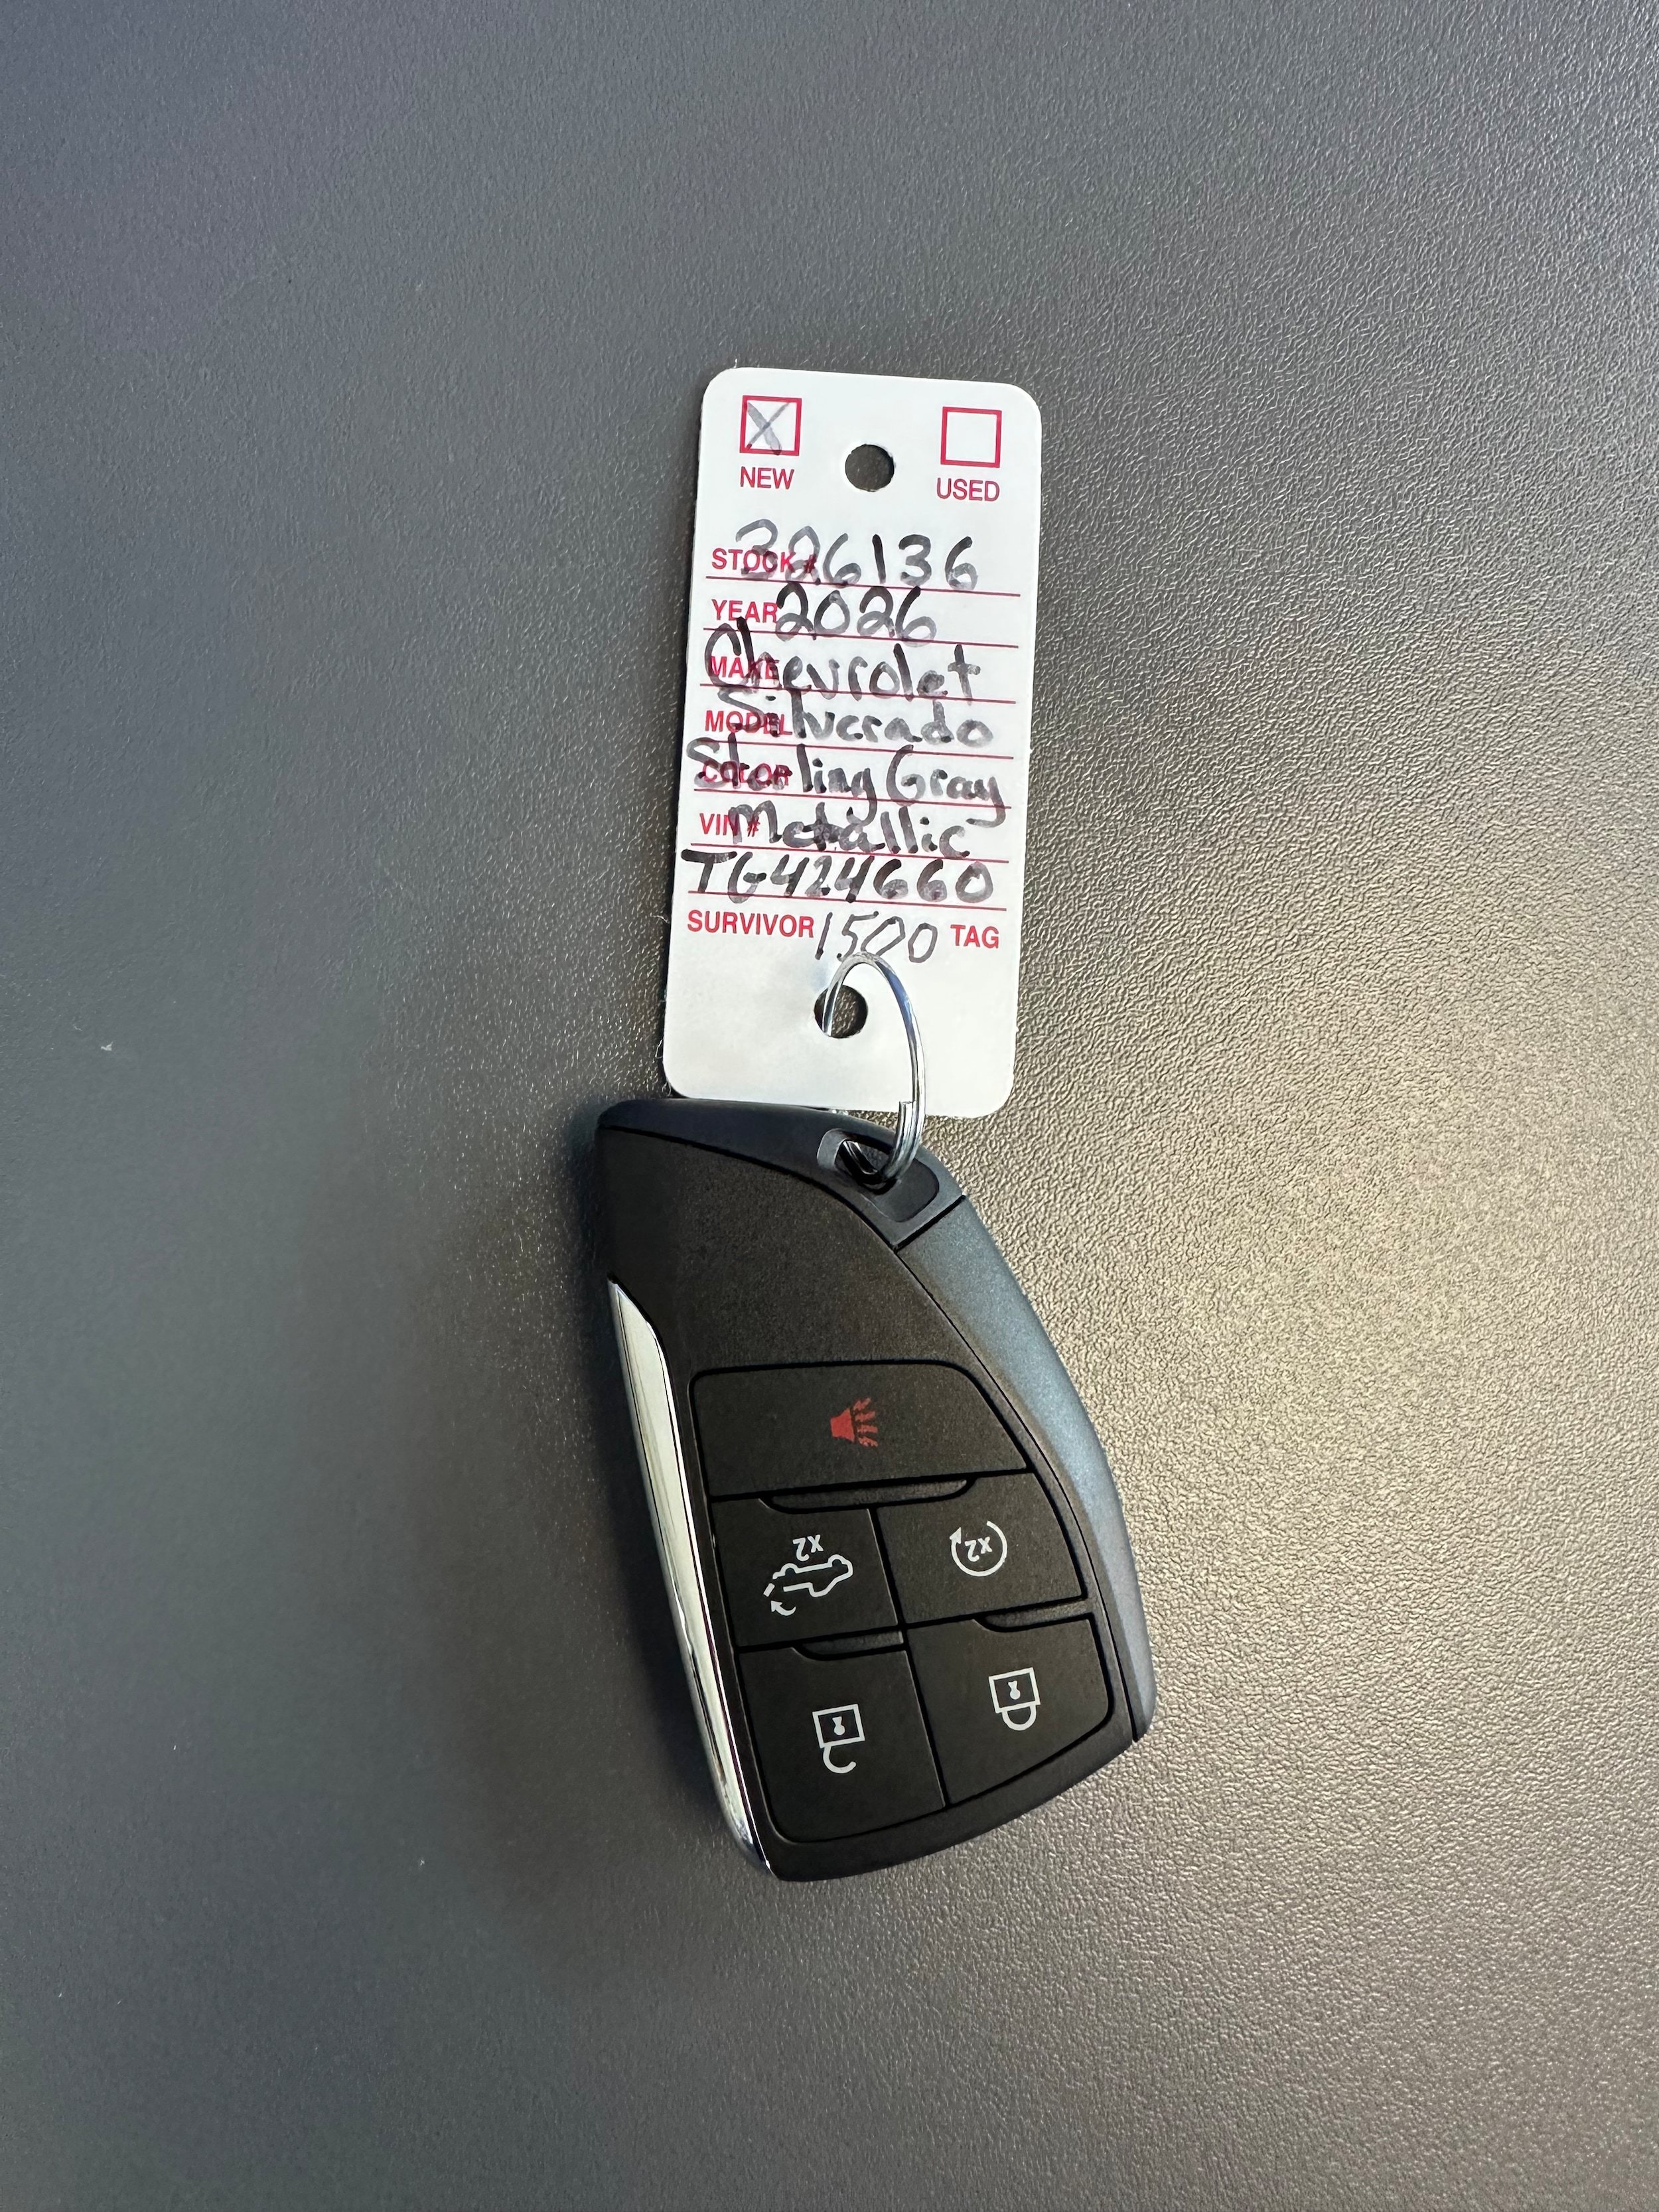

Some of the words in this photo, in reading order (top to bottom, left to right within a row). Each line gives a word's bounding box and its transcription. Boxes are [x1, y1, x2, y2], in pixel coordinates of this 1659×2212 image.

[739, 466, 795, 490] NEW
[936, 477, 1001, 502] USED
[711, 548, 797, 573] STOCK
[711, 599, 778, 624] YEAR
[774, 581, 937, 647] 2026
[704, 616, 981, 705] Chevrolet
[886, 744, 1007, 828] Gray
[687, 909, 814, 938] SURVIVOR
[814, 910, 938, 964] 1500
[950, 923, 1001, 950] TAG
